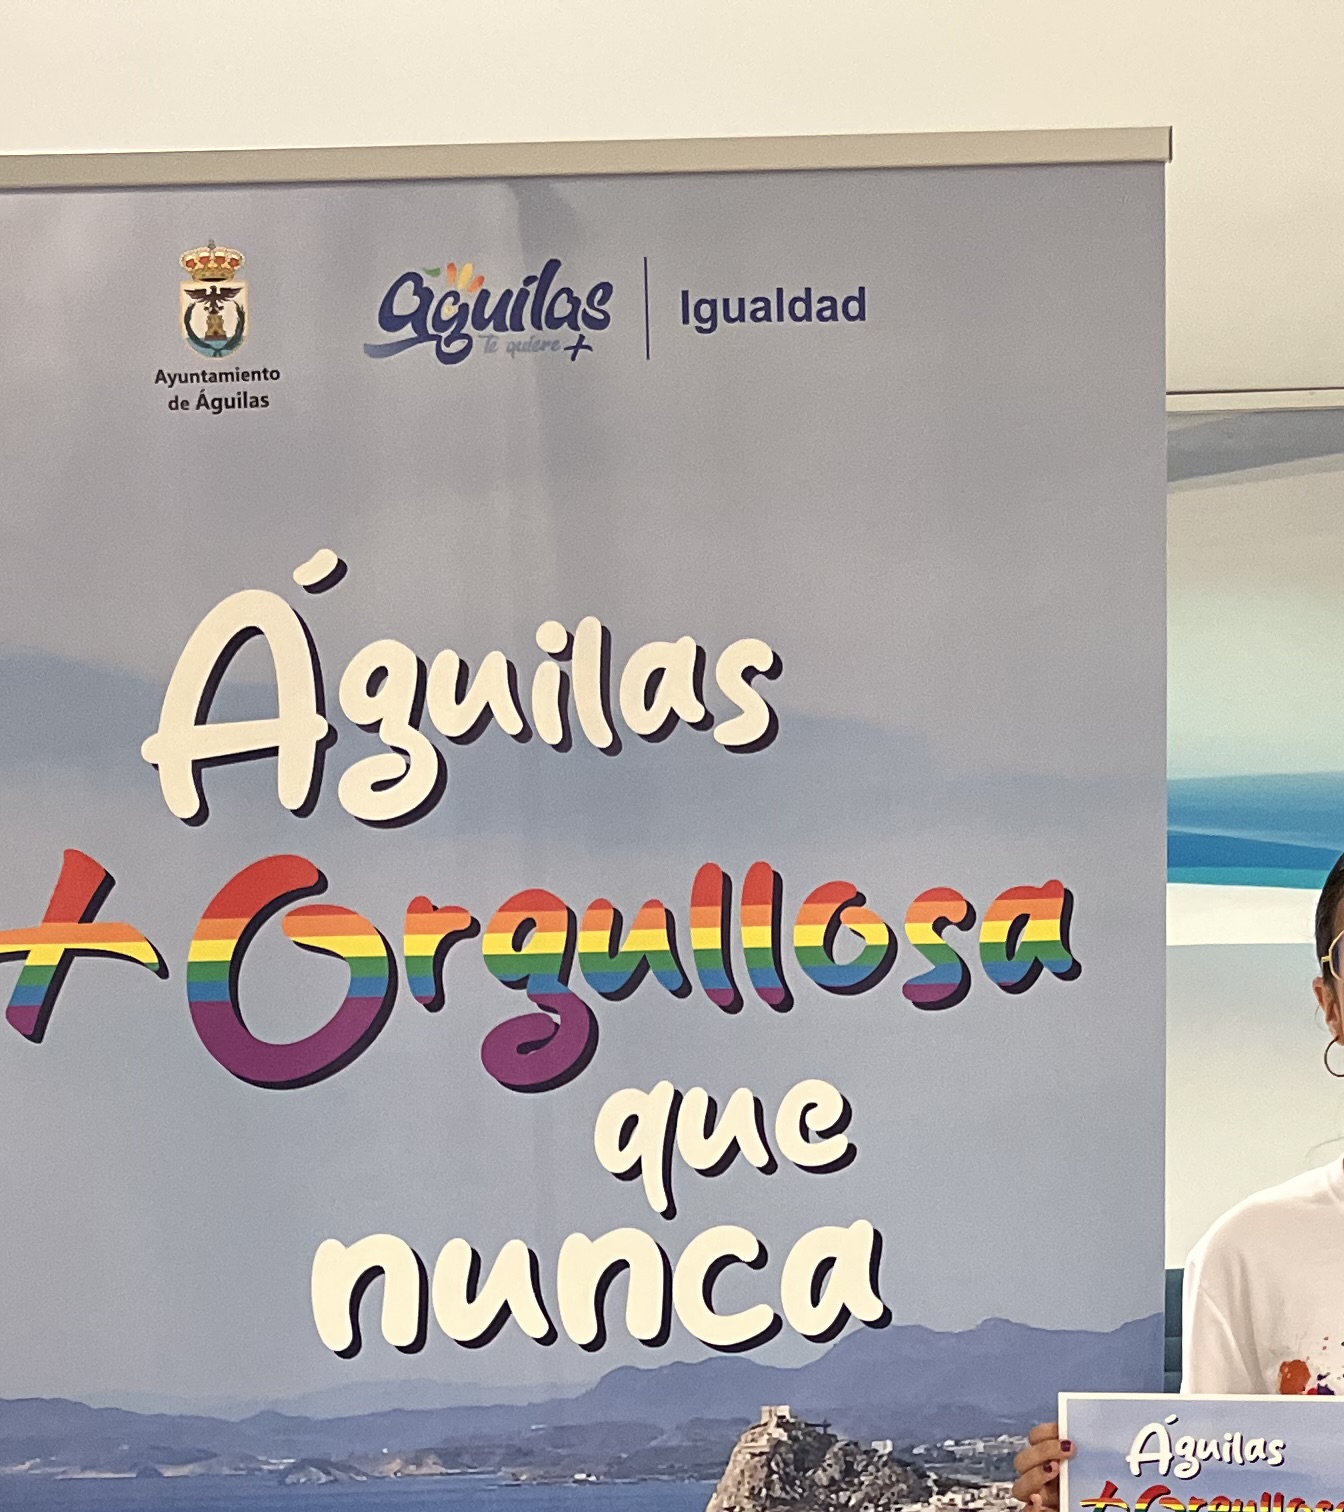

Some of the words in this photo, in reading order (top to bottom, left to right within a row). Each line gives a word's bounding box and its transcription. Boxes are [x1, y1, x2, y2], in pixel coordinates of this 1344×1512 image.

[680, 286, 868, 334] Igualdad
[154, 366, 281, 388] Ayuntamiento
[168, 395, 190, 411] de
[196, 389, 270, 415] Águilas
[141, 548, 783, 829] Águilas
[593, 1078, 859, 1220] que
[310, 1218, 893, 1358] nunca
[1125, 1413, 1287, 1480] Águilas
